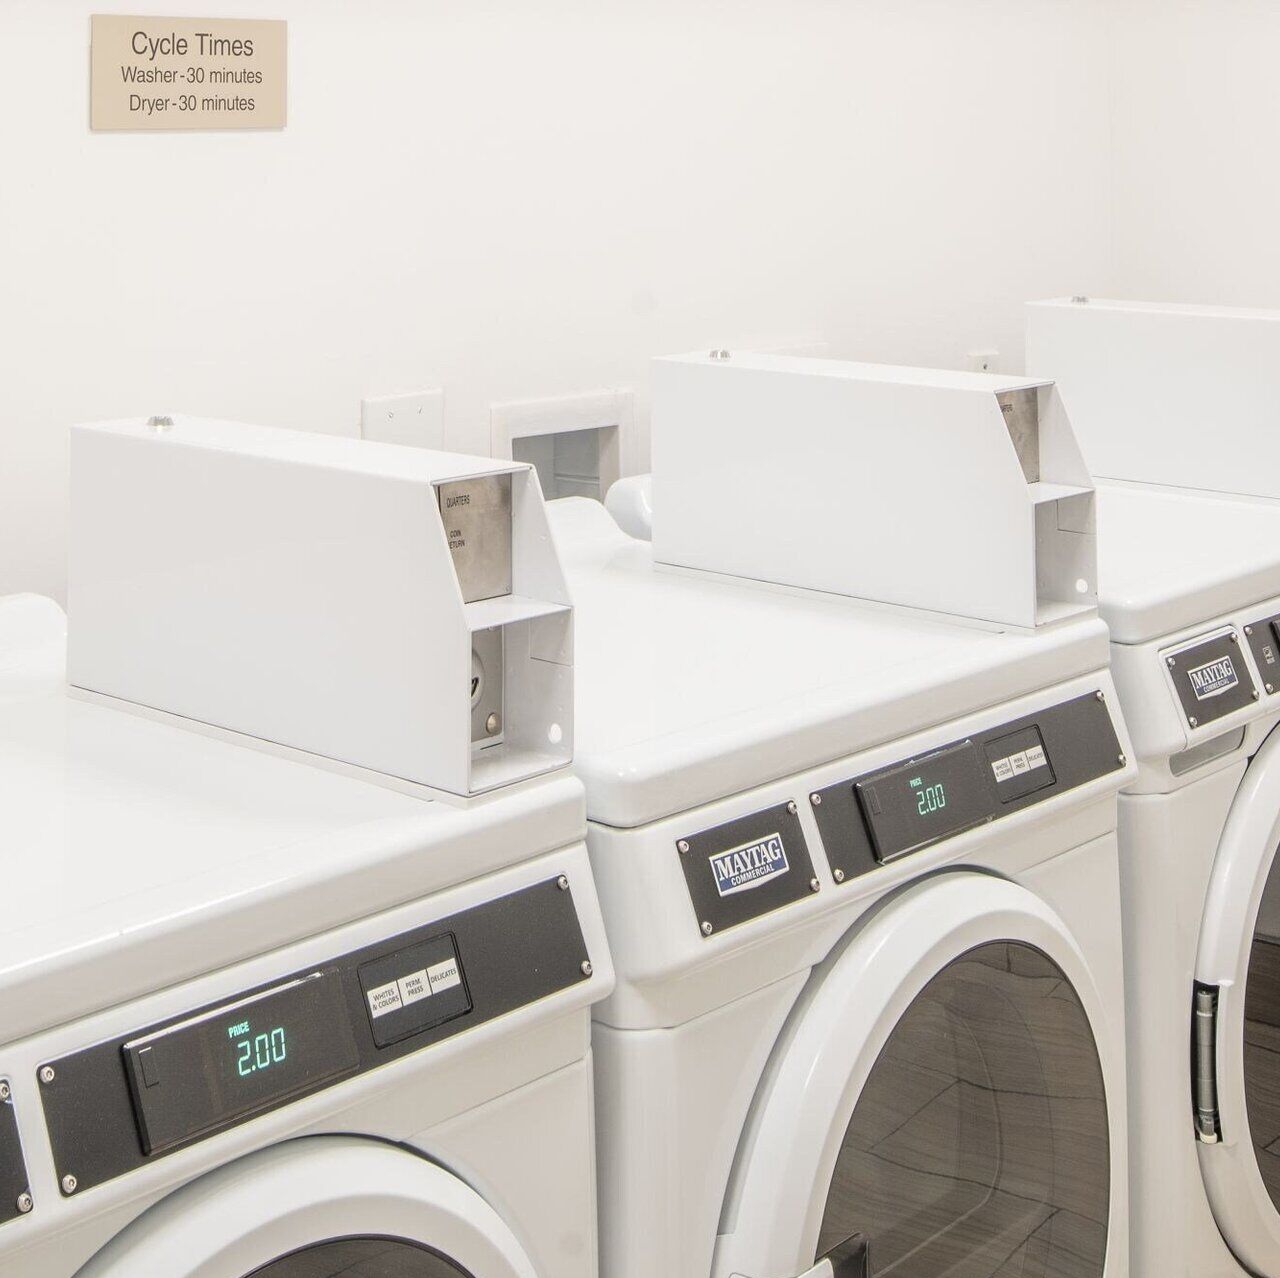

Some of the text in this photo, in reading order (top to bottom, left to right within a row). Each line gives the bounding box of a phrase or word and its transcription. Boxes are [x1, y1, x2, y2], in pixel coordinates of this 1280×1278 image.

[132, 31, 254, 61] Cycle Times
[209, 67, 263, 84] minutes
[201, 95, 256, 112] minutes
[446, 494, 470, 508] QUARTERS
[449, 539, 465, 550] ETURN
[1191, 660, 1233, 689] MAYTAG
[916, 783, 945, 815] 2.00
[715, 839, 781, 881] MAYTAG
[730, 863, 775, 886] COMMERCIAL
[430, 968, 457, 984] DELICATES
[372, 988, 394, 1002] WHITES
[407, 985, 424, 996] PRESS
[378, 995, 400, 1009] COLORS
[228, 1021, 250, 1038] PRICE
[237, 1027, 286, 1076] 2.00
